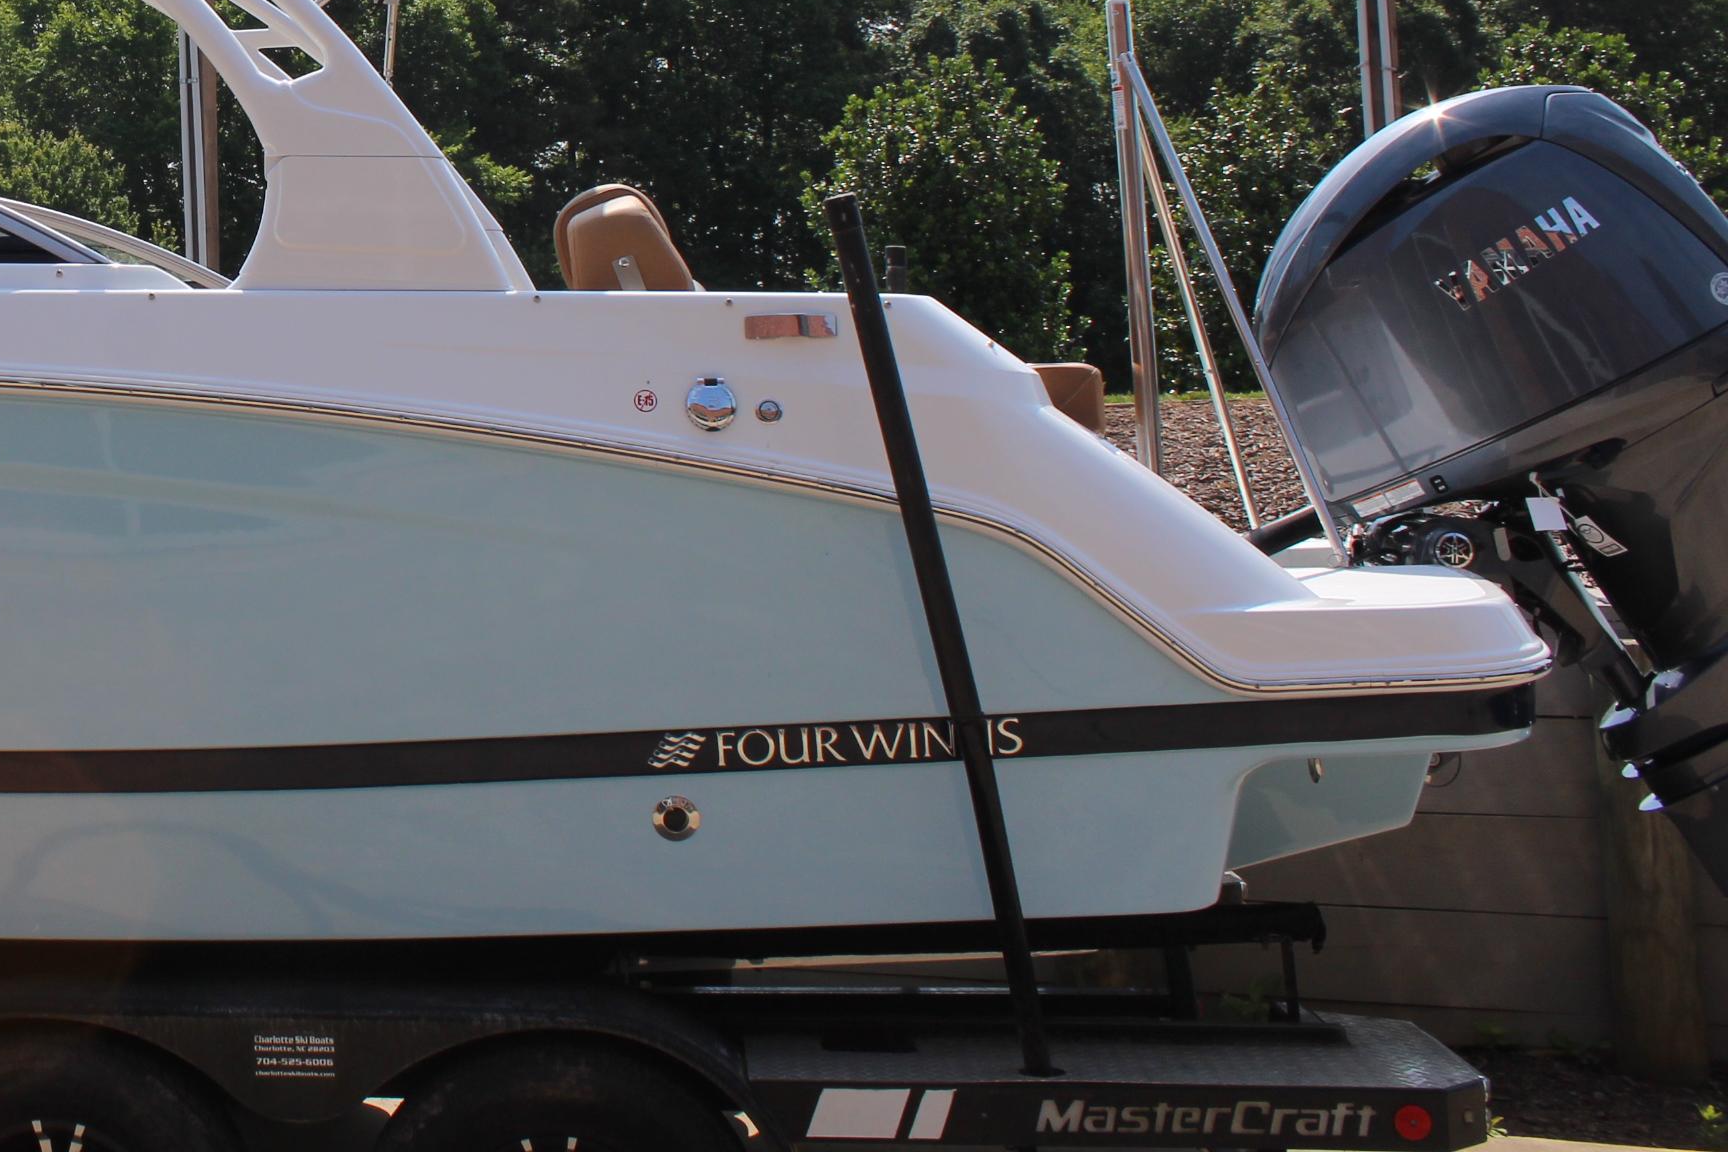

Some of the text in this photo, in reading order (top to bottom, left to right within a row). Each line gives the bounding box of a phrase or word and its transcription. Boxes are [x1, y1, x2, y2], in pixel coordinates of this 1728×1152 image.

[1433, 195, 1602, 311] YAMAHA
[716, 726, 847, 768] FOUR
[254, 1035, 335, 1045] Charlotte Ski Boats
[256, 1057, 334, 1066] 704-525-6006
[1035, 1099, 1376, 1136] MasterCraft
